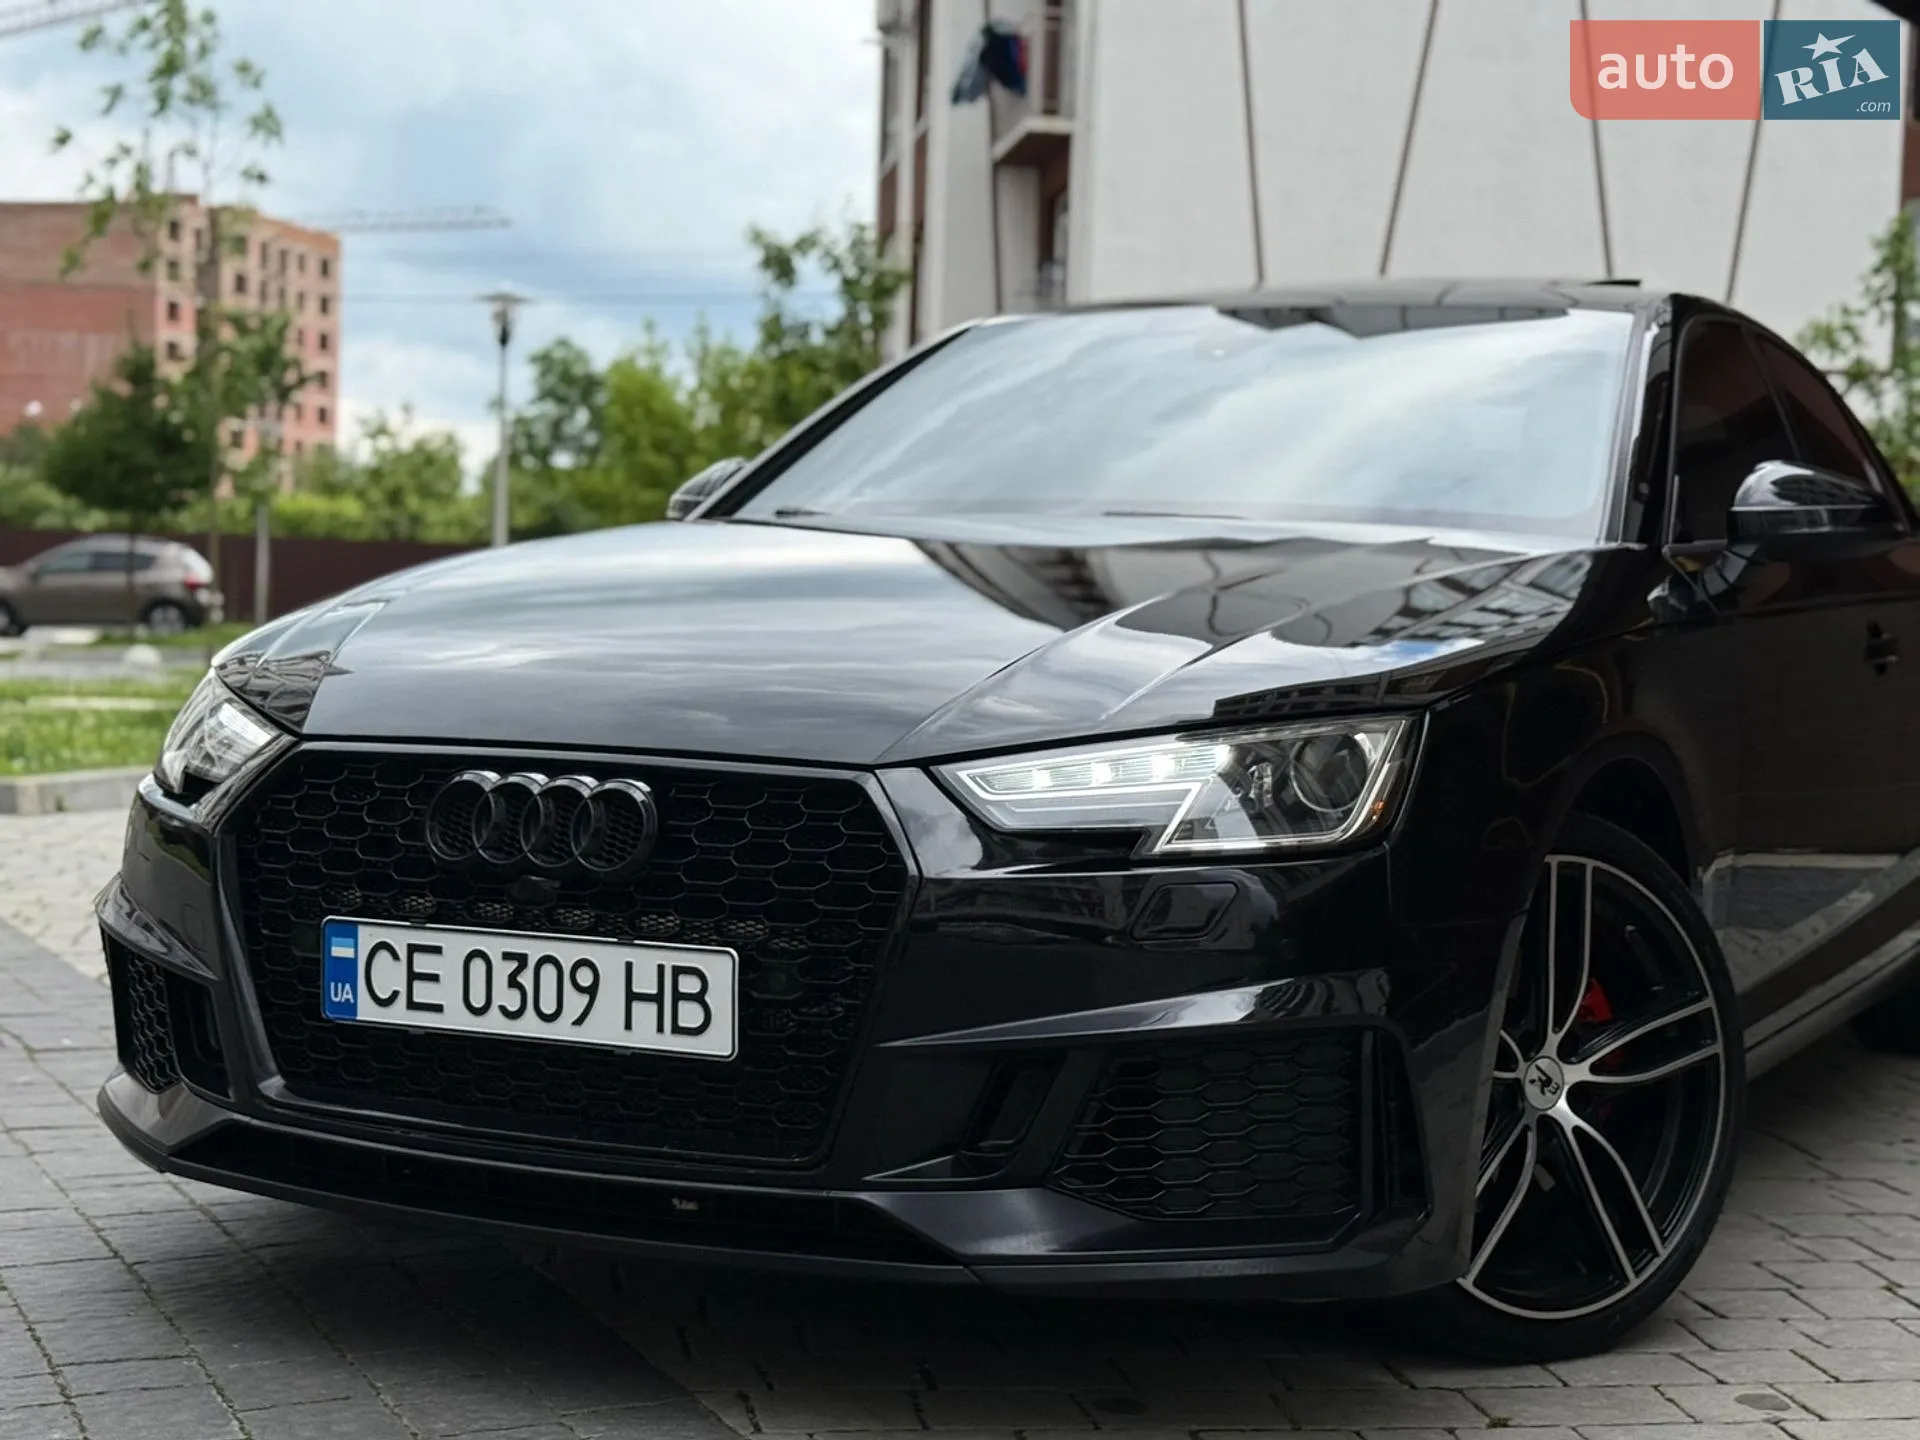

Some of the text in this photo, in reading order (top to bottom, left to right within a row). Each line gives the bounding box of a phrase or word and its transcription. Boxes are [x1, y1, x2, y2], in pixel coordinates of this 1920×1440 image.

[330, 981, 355, 1005] UA
[364, 940, 713, 1037] CE 0309 HB
